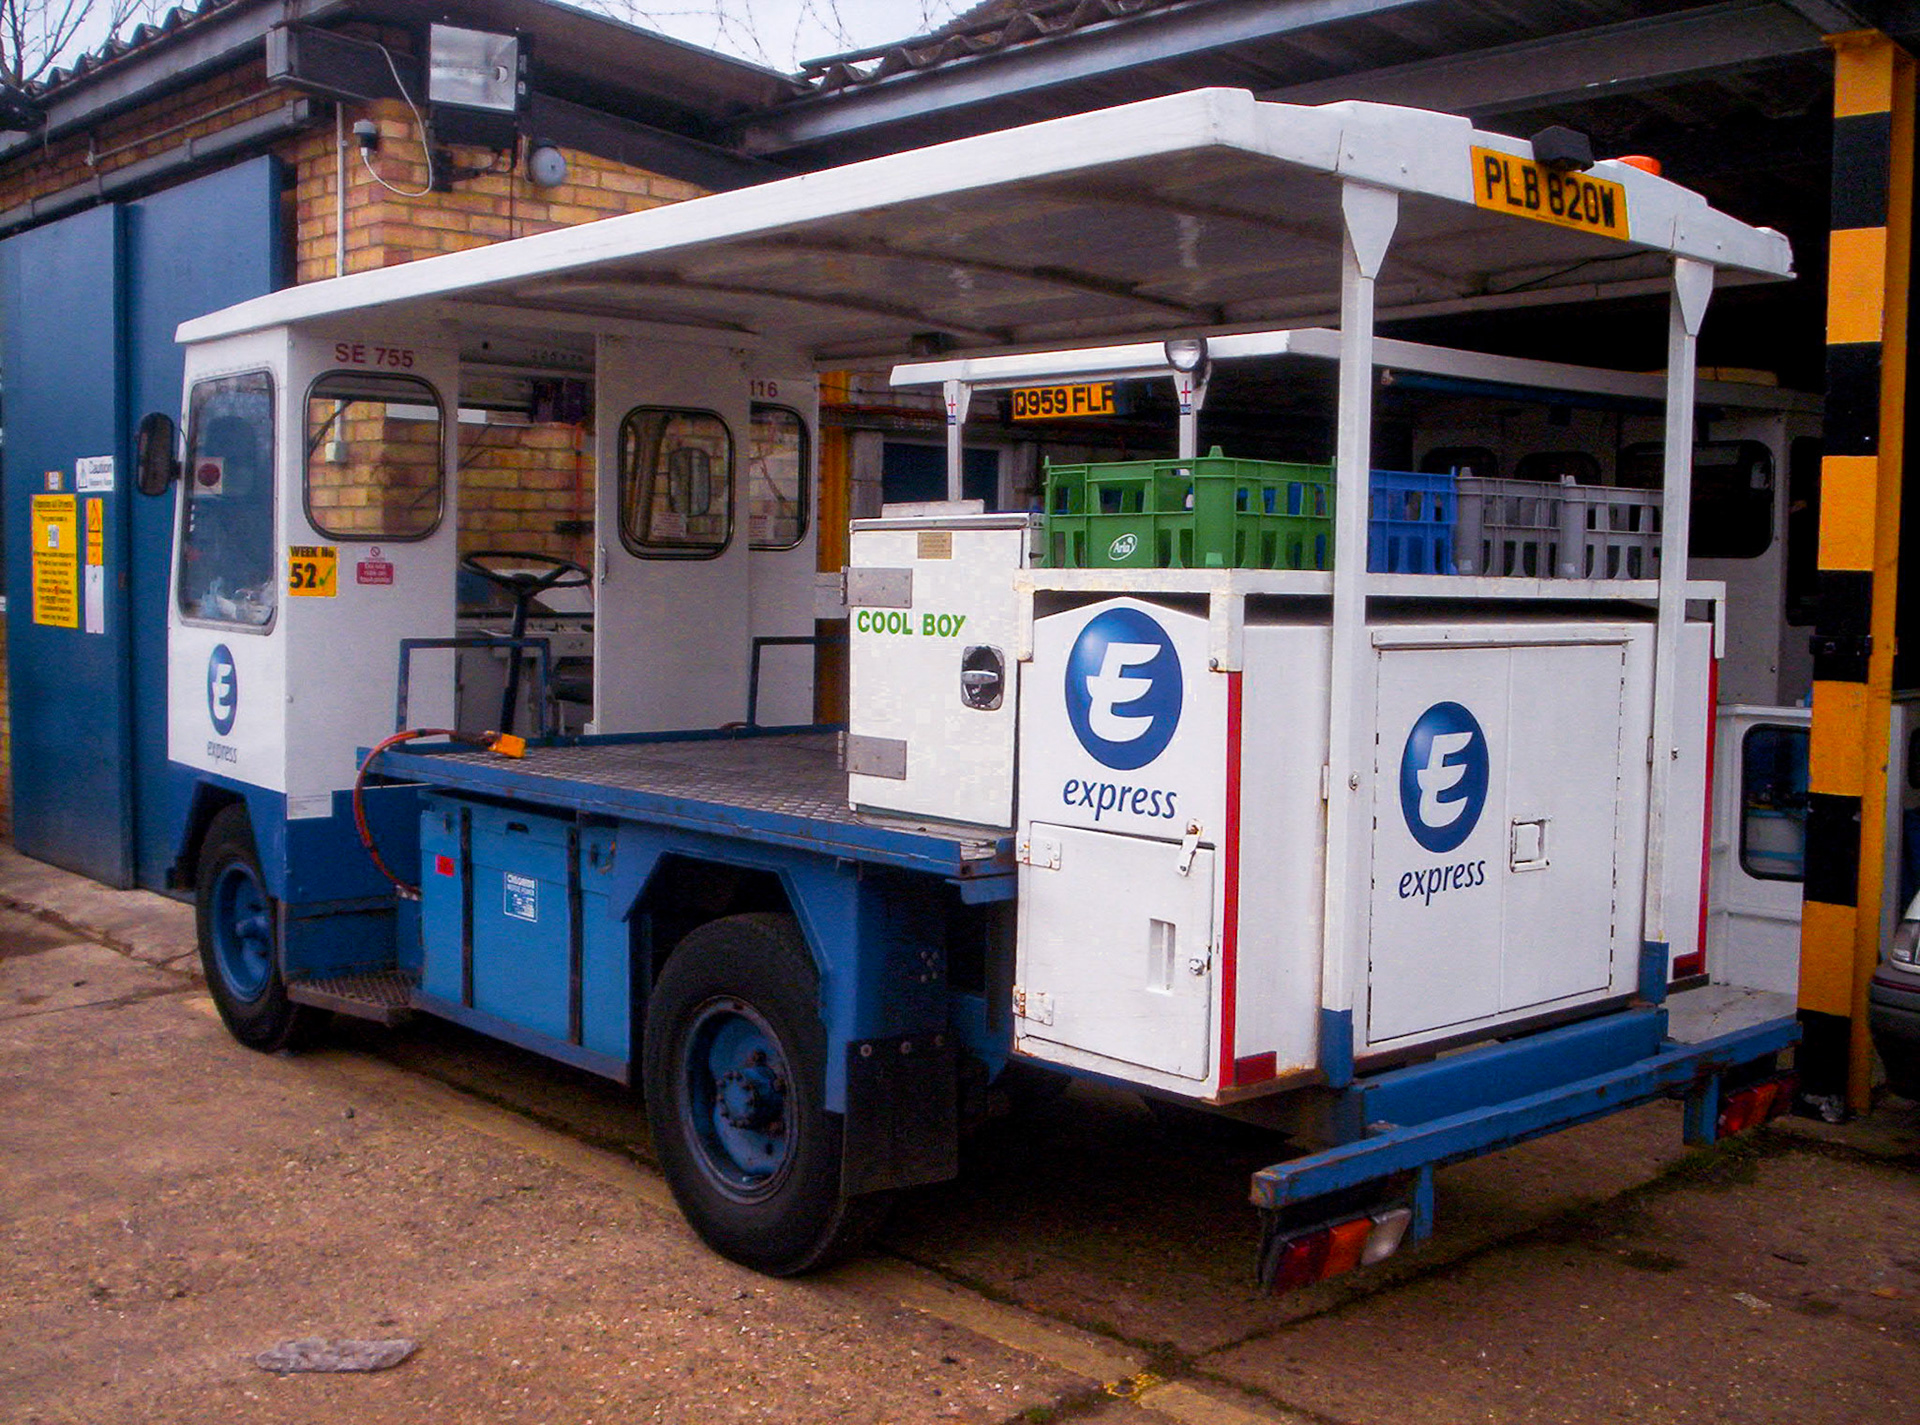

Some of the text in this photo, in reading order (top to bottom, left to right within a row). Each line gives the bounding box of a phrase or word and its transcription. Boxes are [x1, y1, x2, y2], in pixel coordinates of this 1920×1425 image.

[1484, 155, 1616, 228] PLB 820W
[335, 343, 414, 368] SE 755
[751, 380, 778, 397] 116
[290, 546, 317, 557] WEEK
[290, 562, 317, 588] 52
[857, 610, 966, 637] COOL BOY
[207, 741, 237, 764] express
[1063, 778, 1177, 821] express
[1399, 860, 1485, 906] express
